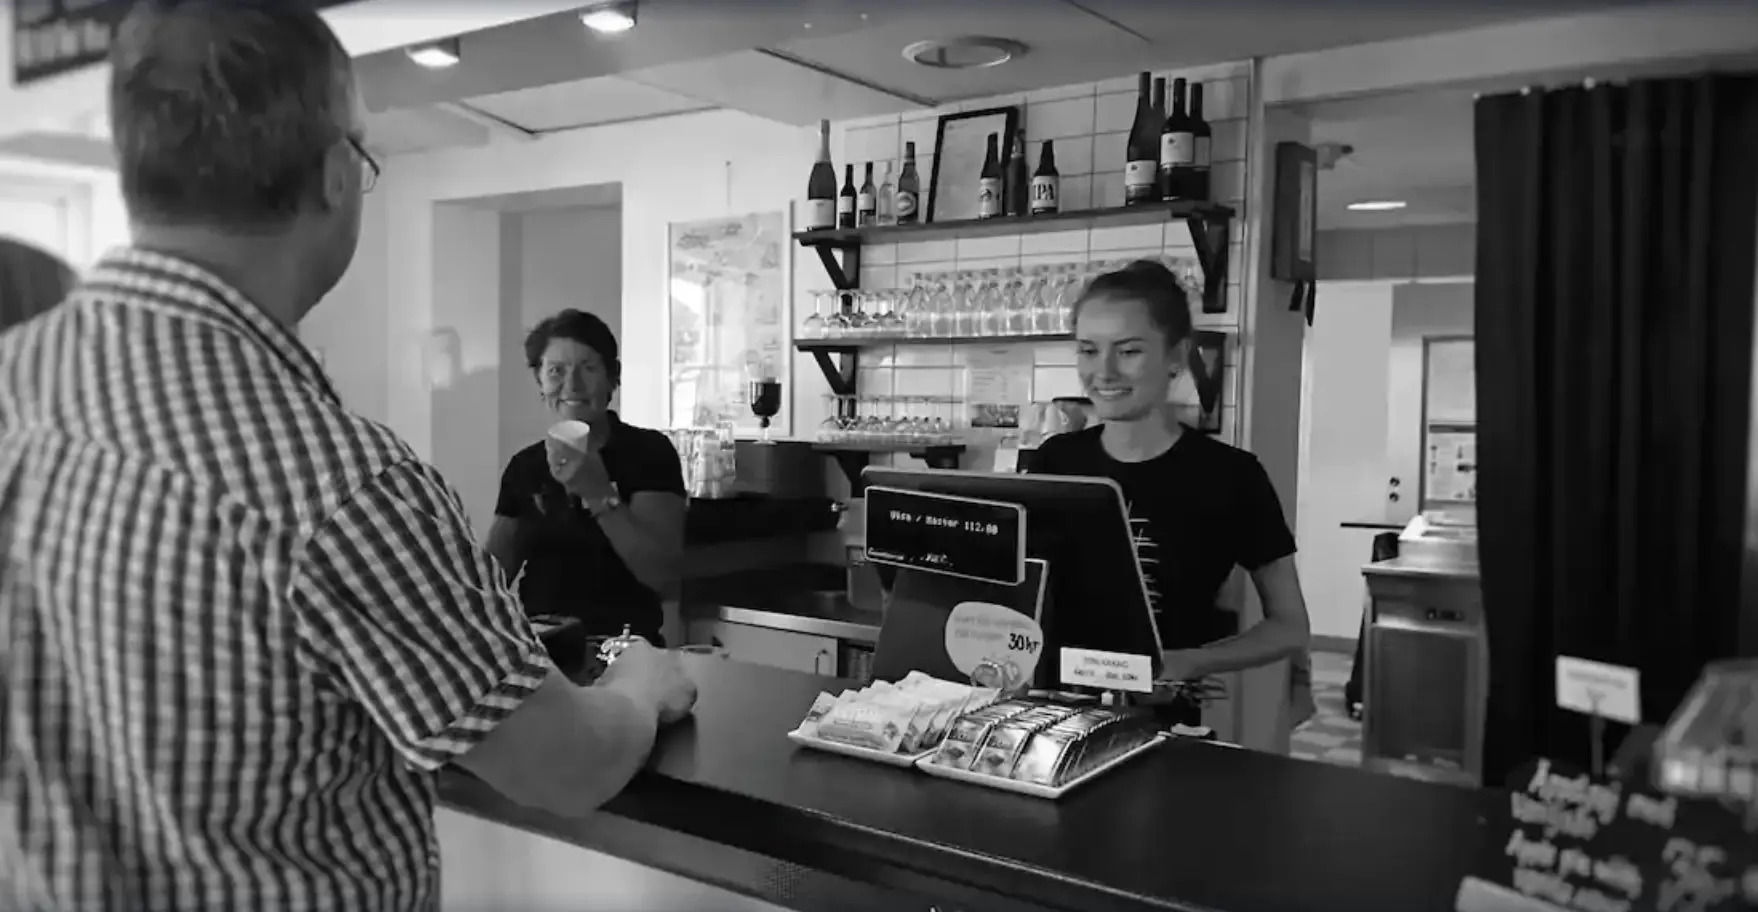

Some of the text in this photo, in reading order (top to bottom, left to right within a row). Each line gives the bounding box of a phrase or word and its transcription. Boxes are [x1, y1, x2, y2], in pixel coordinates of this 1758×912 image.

[1033, 183, 1054, 200] IPA
[890, 510, 912, 523] Visa
[925, 515, 959, 528] Master
